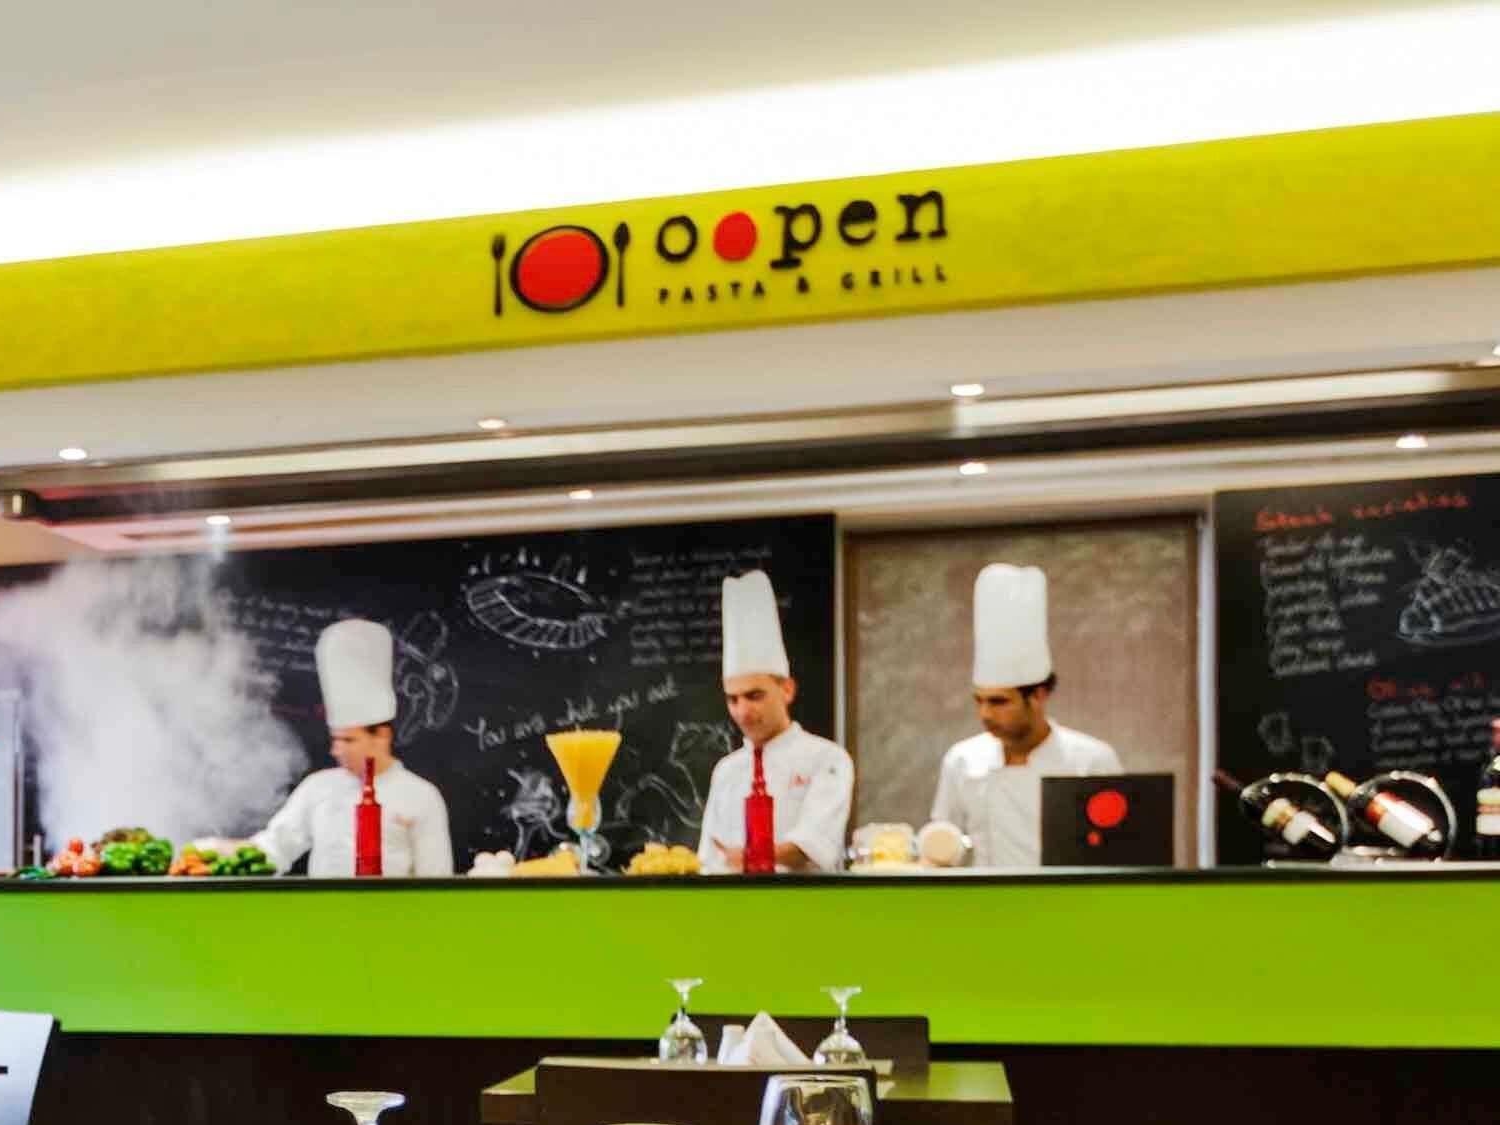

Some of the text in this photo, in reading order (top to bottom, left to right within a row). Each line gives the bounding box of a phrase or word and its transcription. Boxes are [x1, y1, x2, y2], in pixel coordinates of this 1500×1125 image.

[658, 264, 947, 304] PASTA & GRILL
